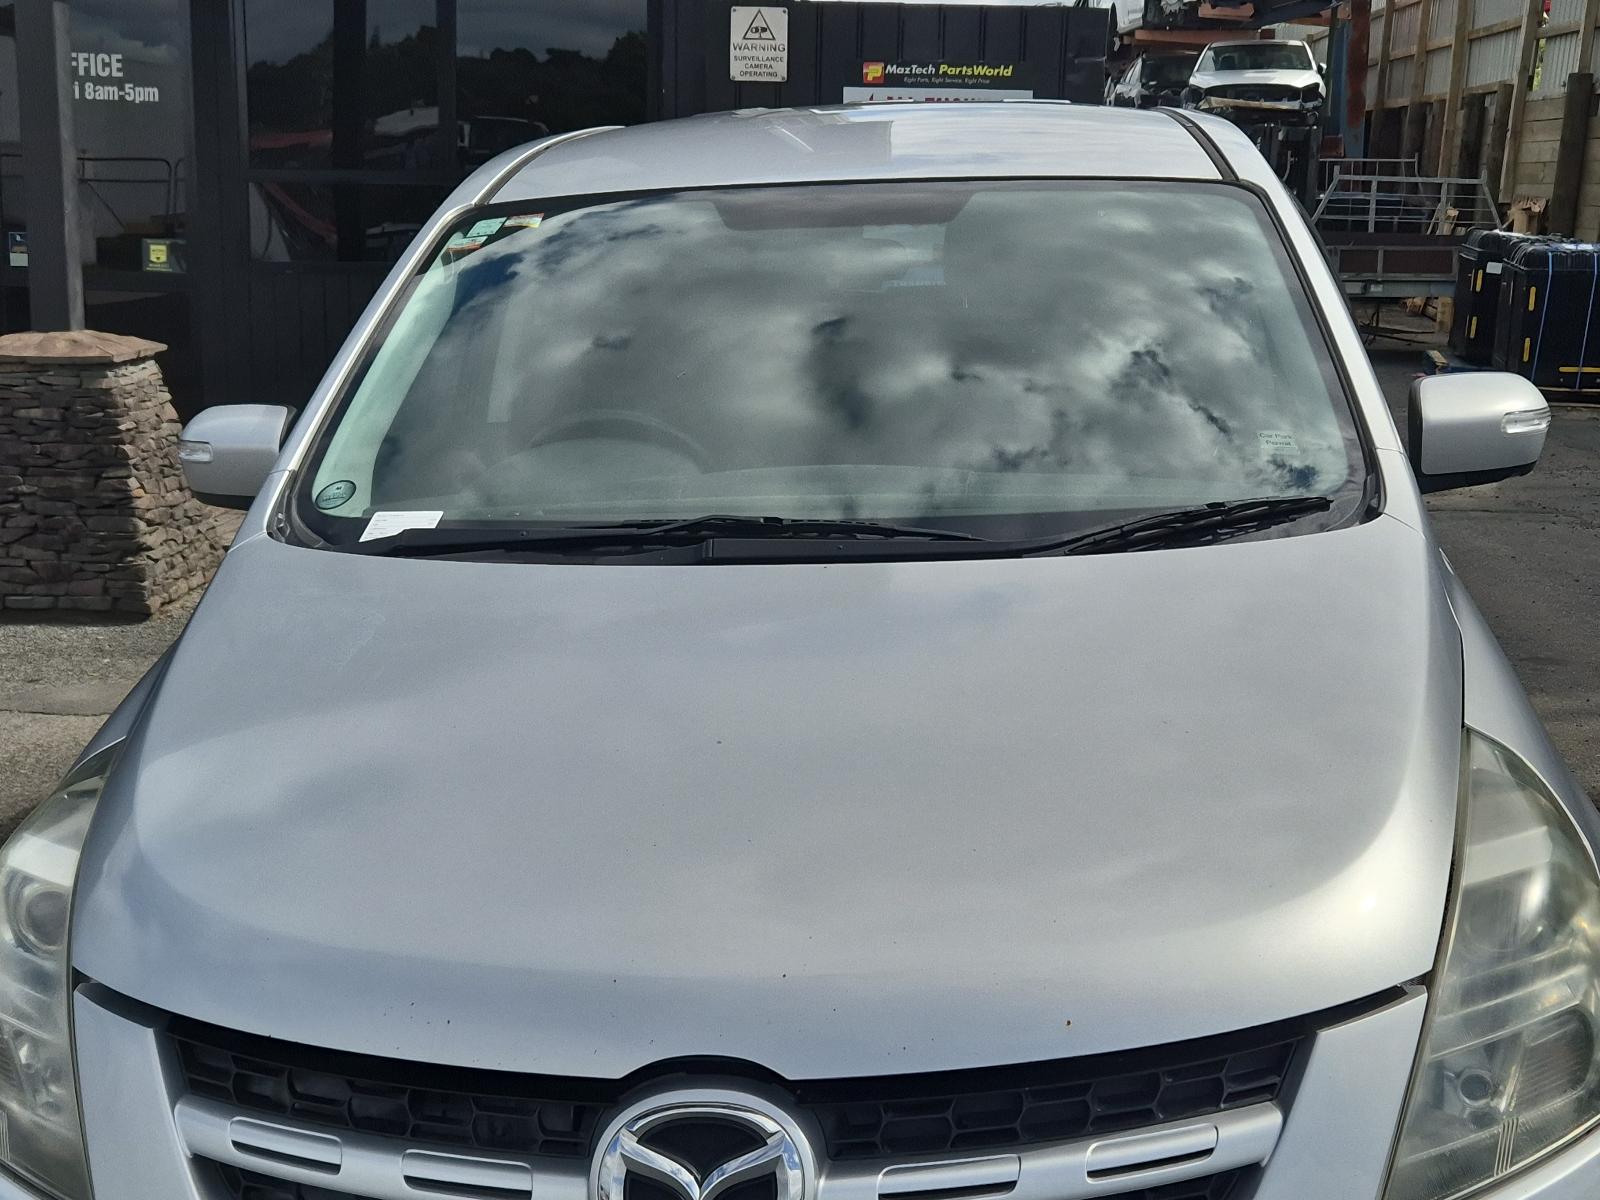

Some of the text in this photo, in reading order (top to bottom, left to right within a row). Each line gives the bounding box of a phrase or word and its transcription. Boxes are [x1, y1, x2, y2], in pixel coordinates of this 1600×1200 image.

[733, 42, 785, 52] WARNING
[734, 55, 784, 63] SURVEILLANCE
[739, 70, 778, 78] OPERATING
[885, 63, 1013, 77] MazTech PartsWorld
[84, 82, 159, 104] 8am-5pm
